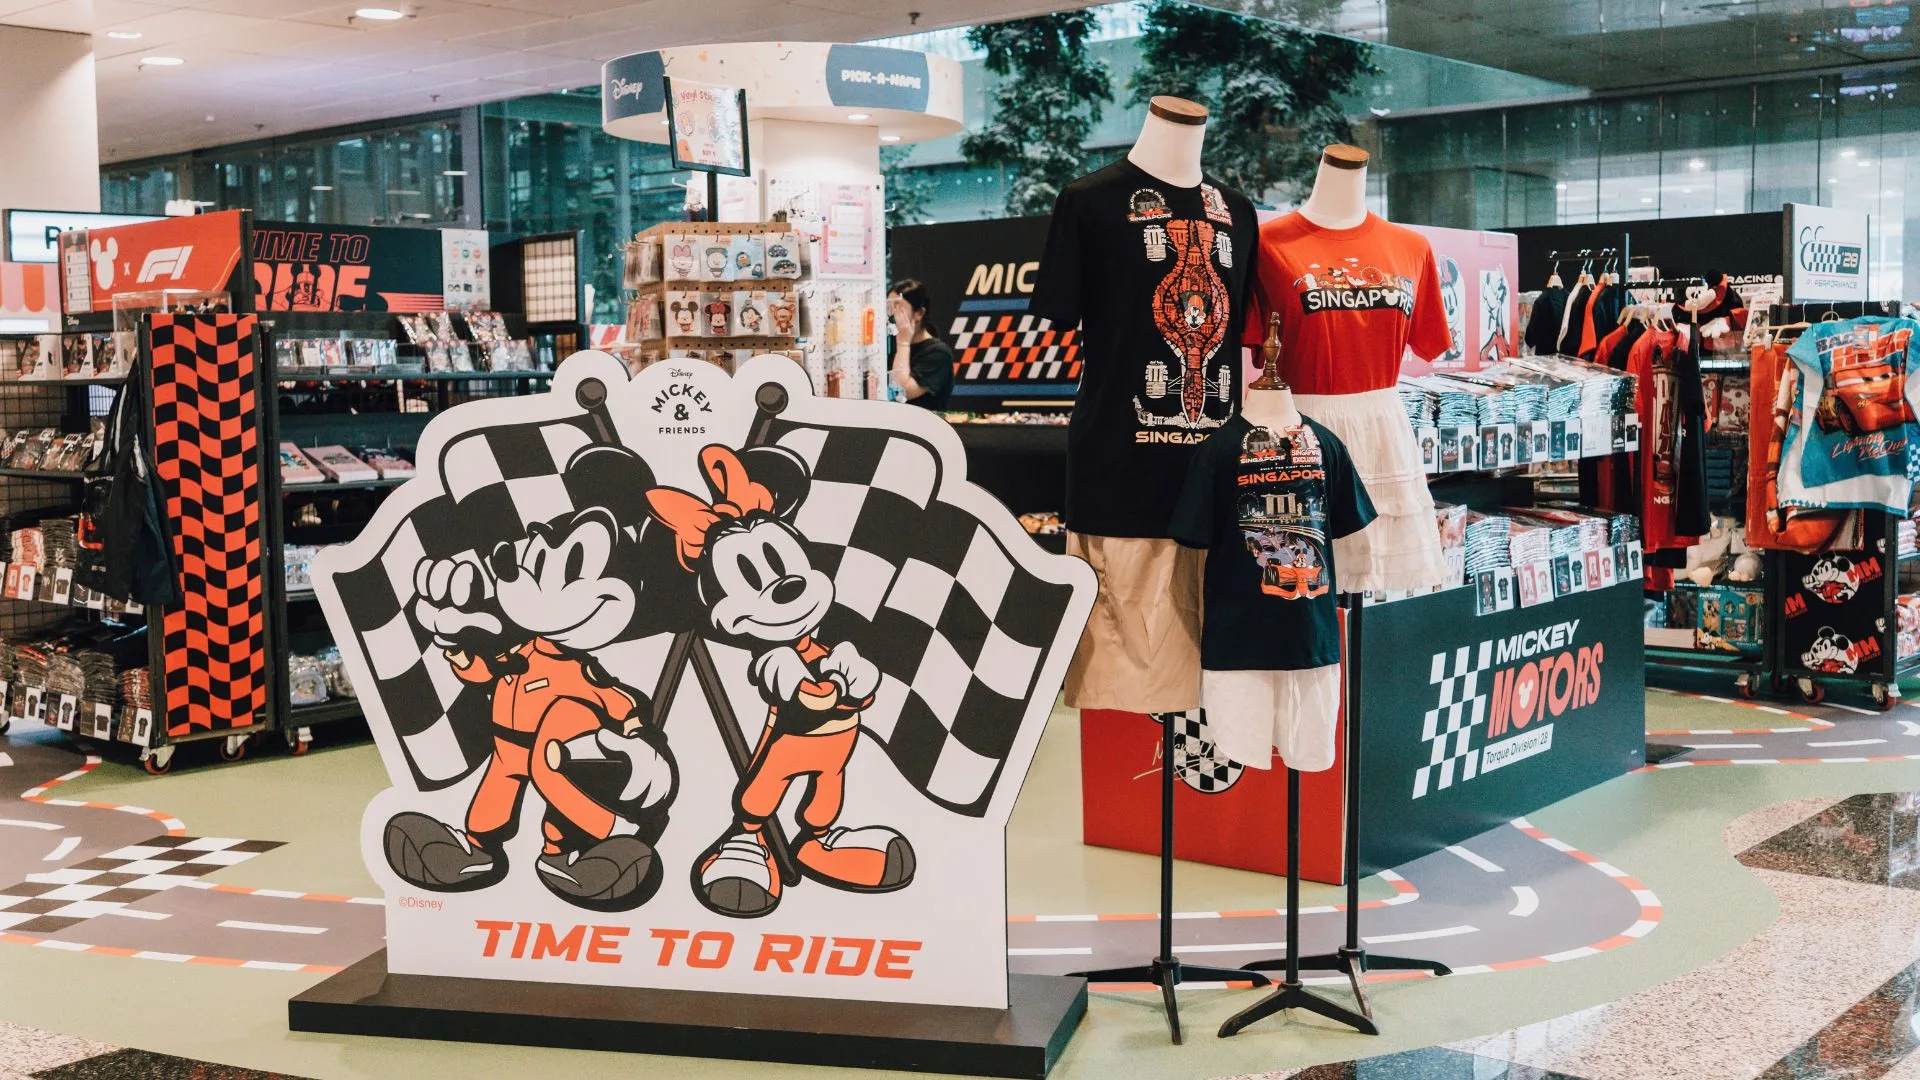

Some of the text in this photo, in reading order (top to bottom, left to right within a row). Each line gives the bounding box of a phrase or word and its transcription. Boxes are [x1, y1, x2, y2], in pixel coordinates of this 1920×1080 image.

[611, 78, 643, 101] Disney
[252, 229, 370, 264] IME TO
[136, 245, 194, 284] F1
[1728, 274, 1773, 284] RACING
[668, 367, 694, 379] Disney
[650, 383, 713, 414] MICKEY
[673, 403, 690, 421] &
[658, 426, 706, 435] FRIENDS
[1135, 430, 1211, 445] SINGAP
[1237, 469, 1326, 486] SINGAPORE
[1496, 619, 1580, 664] MICKEY
[1487, 641, 1604, 739] MOTORS
[1486, 747, 1510, 765] Torque
[1510, 738, 1537, 756] Division
[474, 919, 923, 979] TIME TO RIDE
